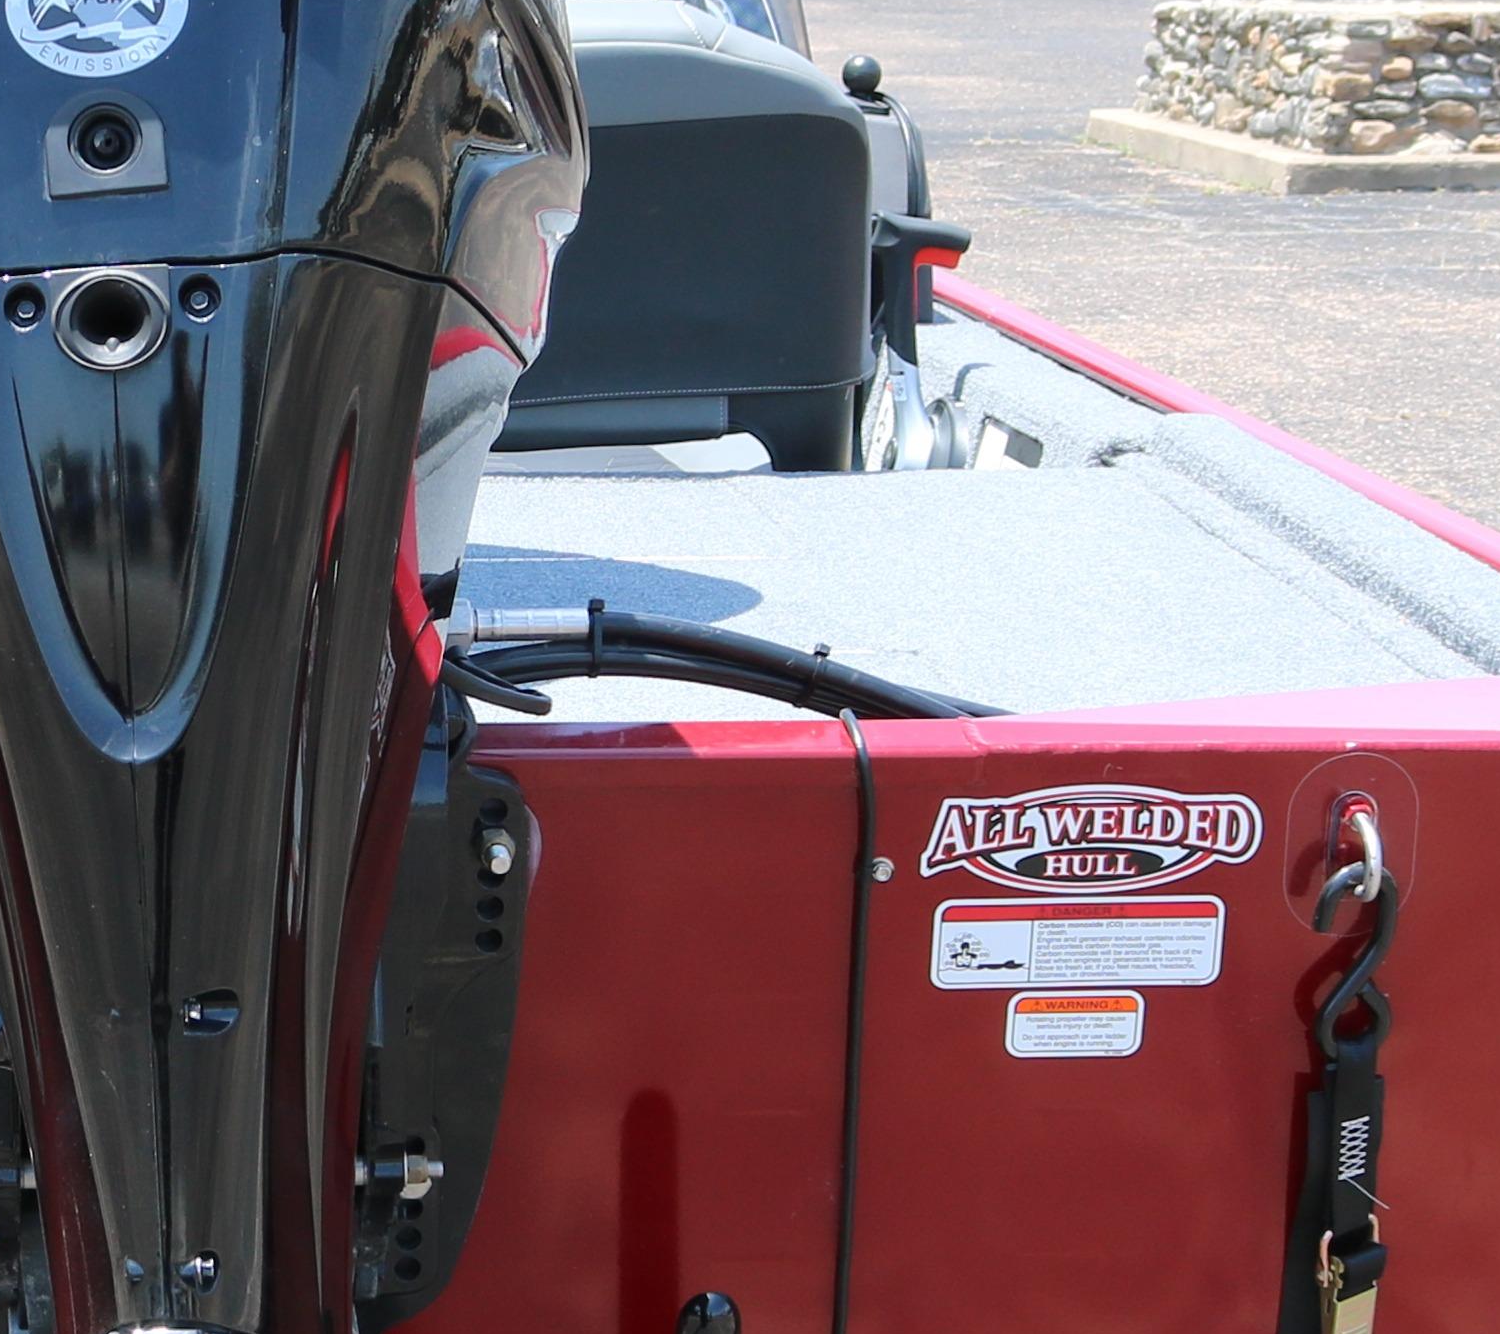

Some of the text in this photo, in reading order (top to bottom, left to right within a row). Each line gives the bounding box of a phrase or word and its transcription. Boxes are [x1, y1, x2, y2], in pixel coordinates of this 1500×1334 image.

[38, 39, 159, 73] EMISSION
[929, 800, 1254, 864] ALL WELDED
[1043, 853, 1137, 878] HULL
[1052, 906, 1112, 916] DANGER
[1045, 1000, 1108, 1010] WARNING
